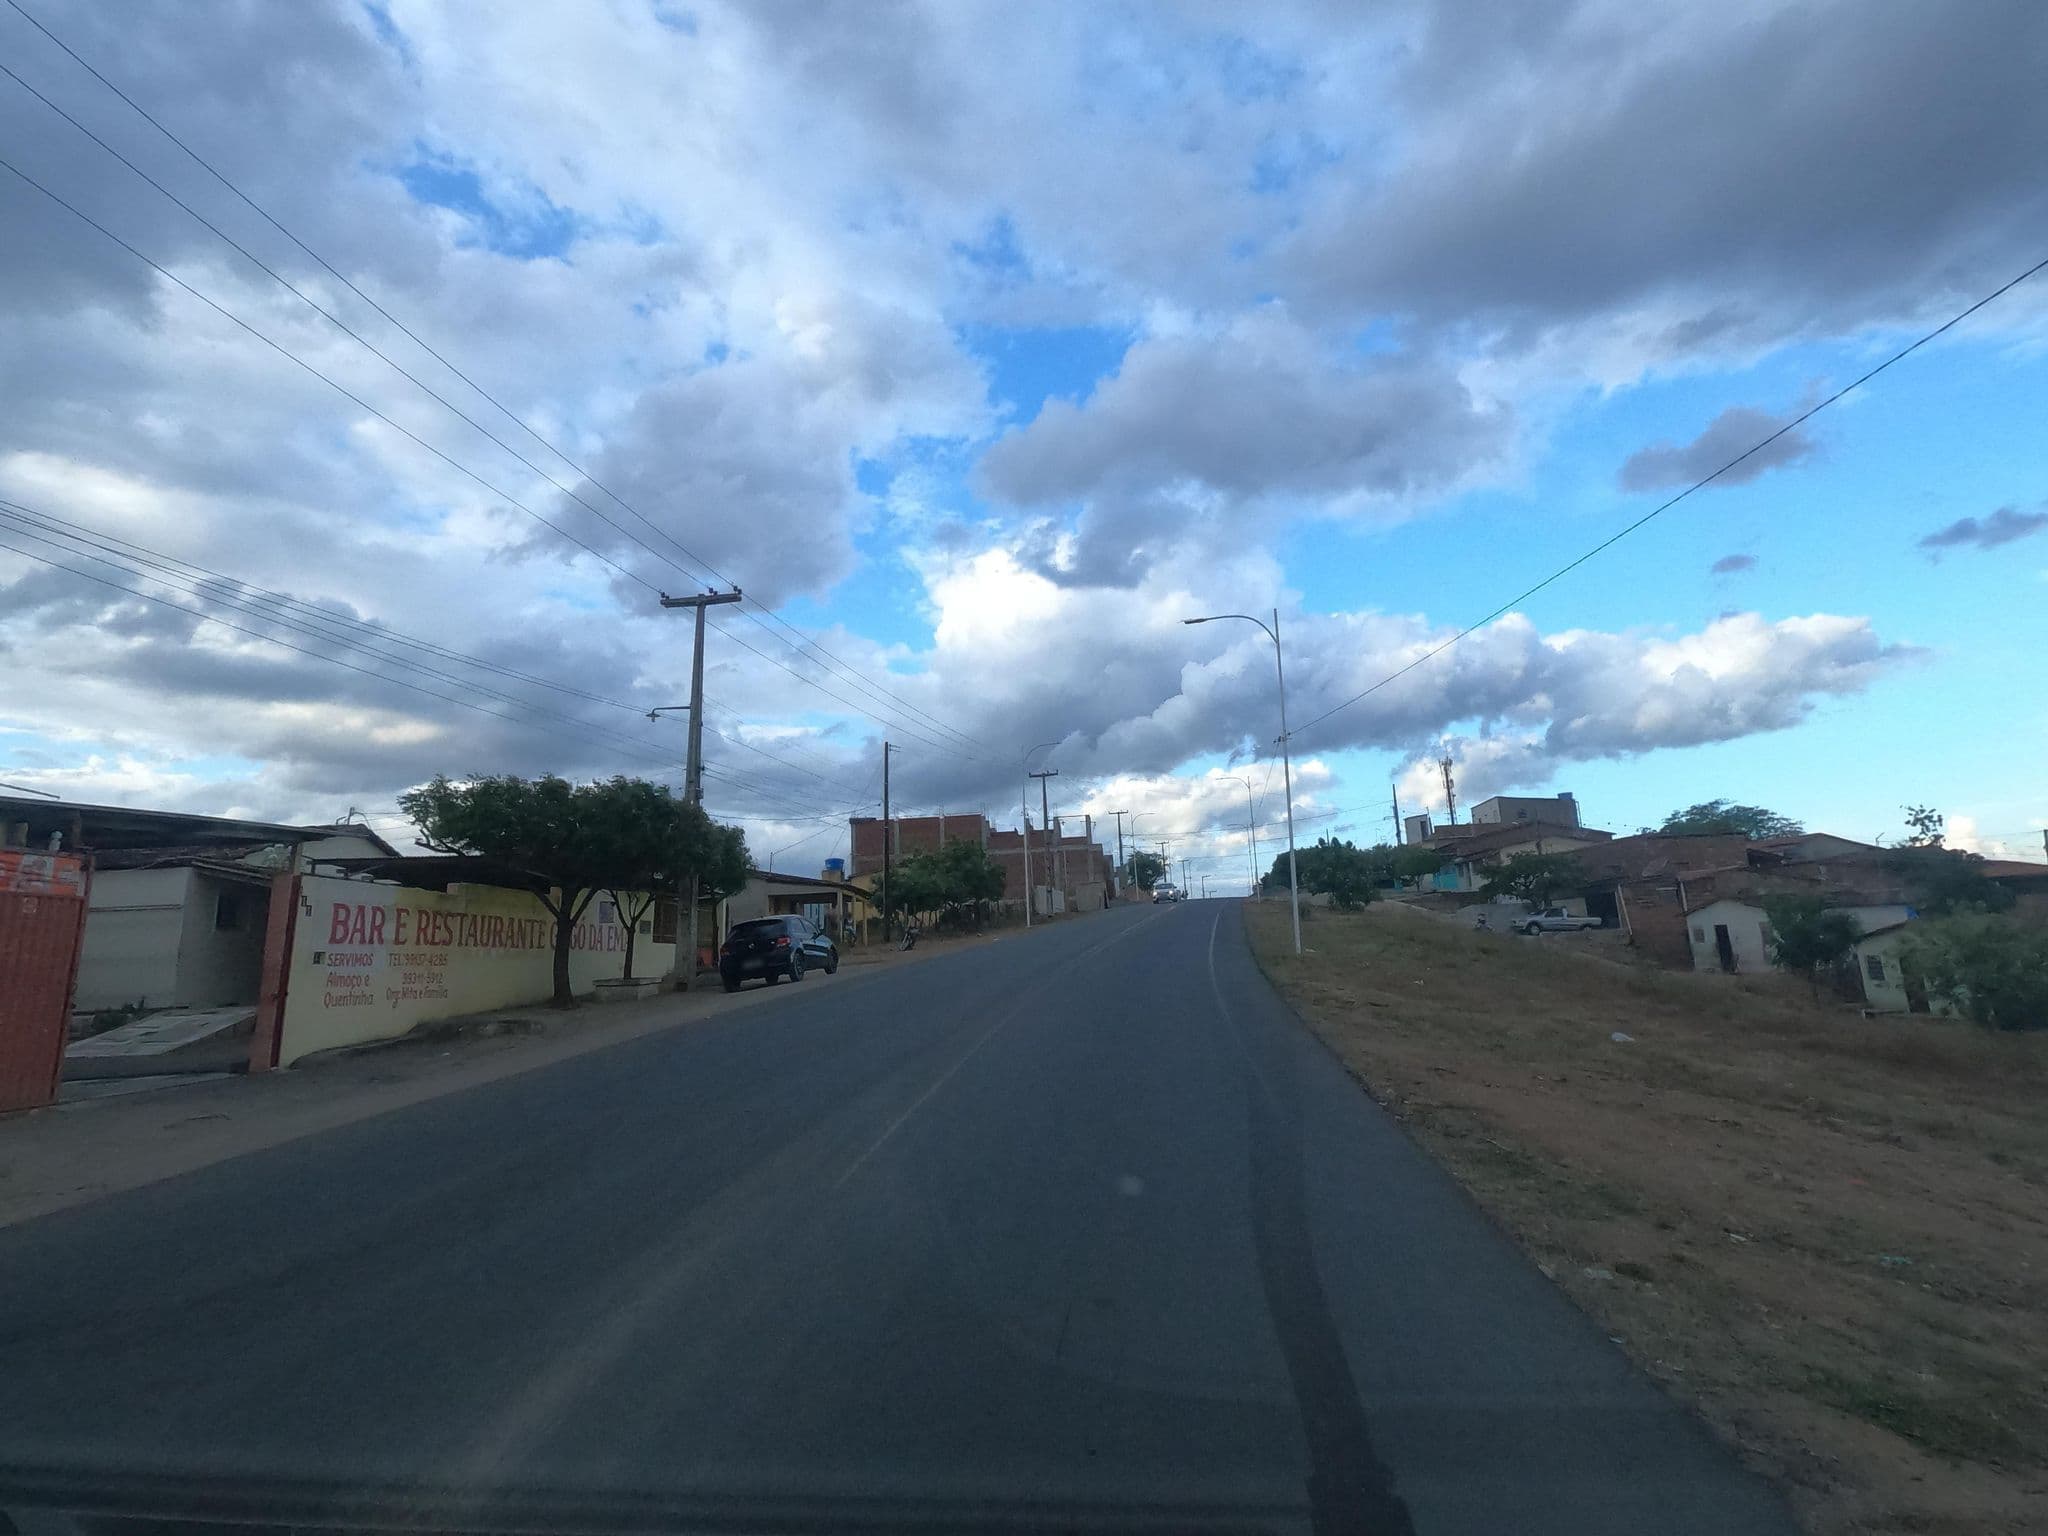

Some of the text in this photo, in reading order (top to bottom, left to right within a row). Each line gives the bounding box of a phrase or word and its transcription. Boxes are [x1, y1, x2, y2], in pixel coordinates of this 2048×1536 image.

[328, 903, 386, 945] BAR
[393, 907, 410, 945] E
[415, 909, 546, 948] RESTAURANTE
[589, 924, 603, 951] DA
[327, 952, 374, 967] SERVIMOS
